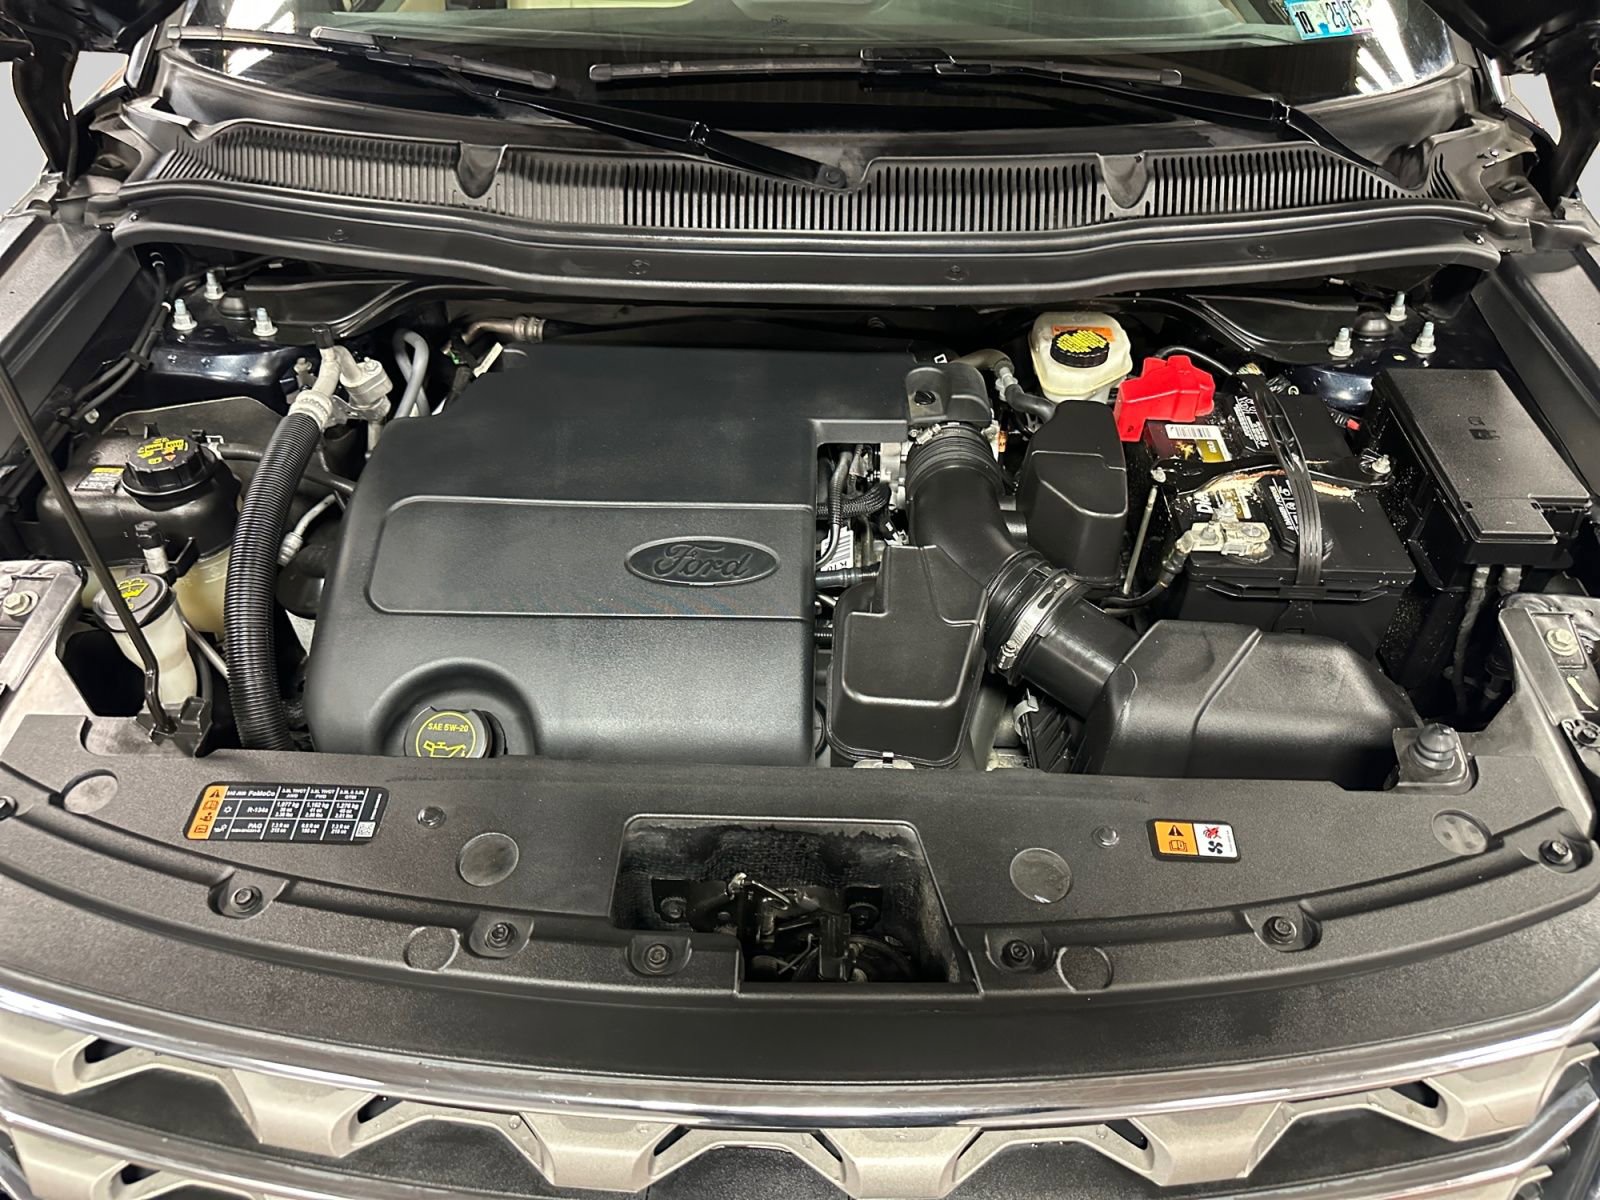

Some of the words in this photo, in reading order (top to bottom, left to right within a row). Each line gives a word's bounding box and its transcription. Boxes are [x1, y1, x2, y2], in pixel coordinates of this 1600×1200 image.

[1295, 11, 1315, 34] 10
[1325, 2, 1346, 28] 25
[653, 544, 753, 577] Ford
[428, 723, 442, 731] SAE
[443, 723, 469, 732] 5W-20
